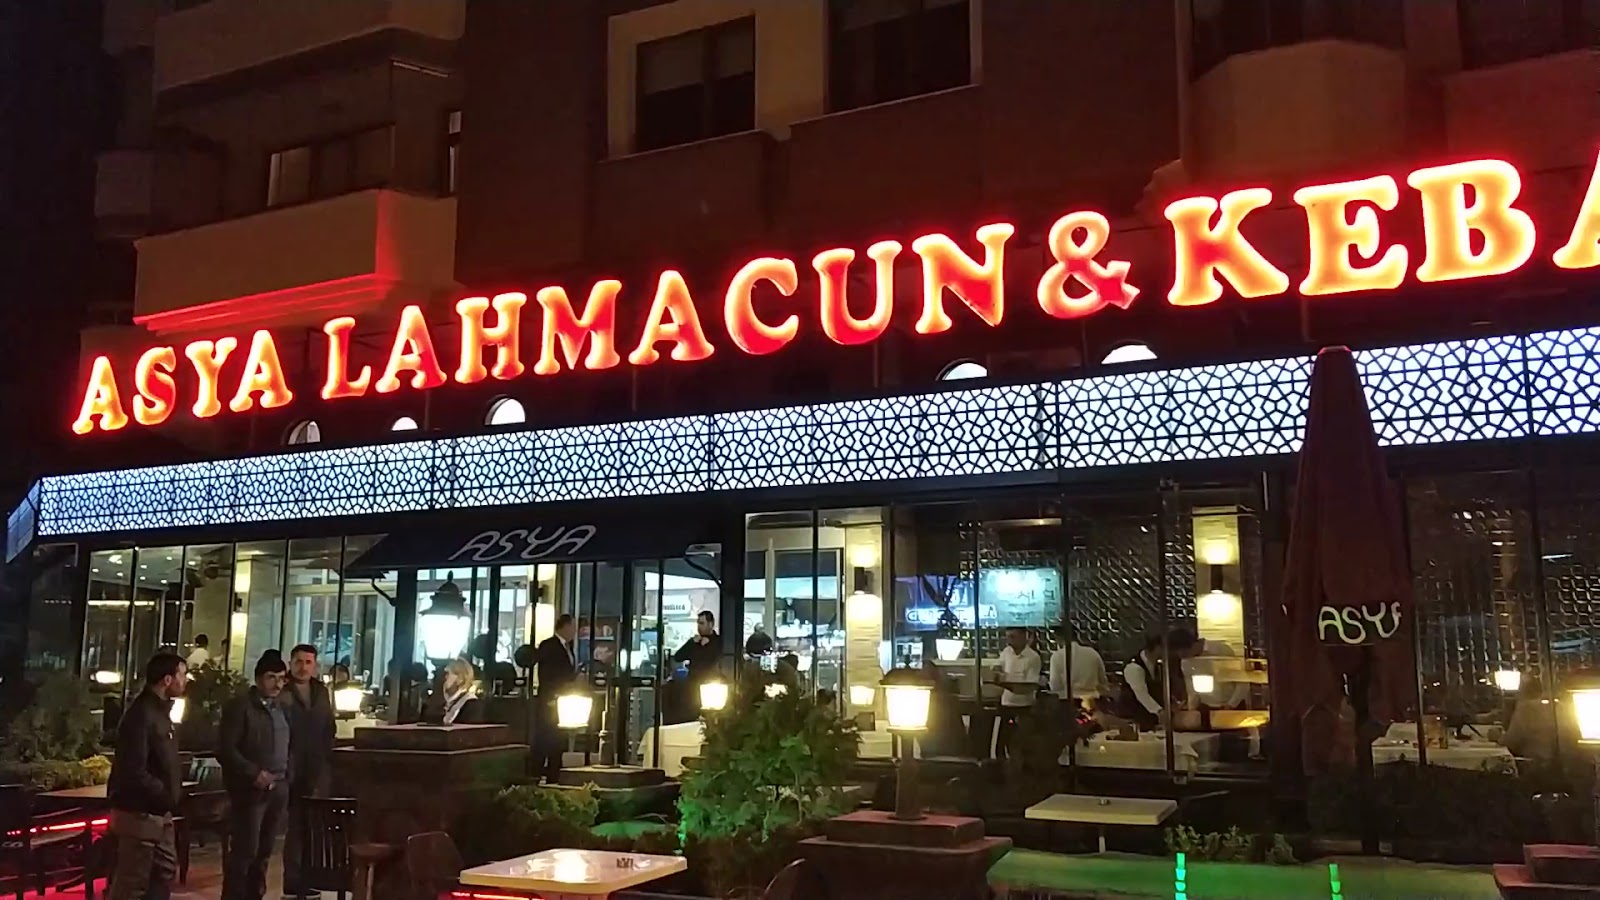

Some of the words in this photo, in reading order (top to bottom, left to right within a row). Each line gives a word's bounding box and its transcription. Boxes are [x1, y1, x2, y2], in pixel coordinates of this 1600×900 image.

[72, 329, 294, 435] ASYA
[321, 222, 1015, 400] LAHMACUN
[1036, 210, 1140, 318] &
[448, 524, 597, 561] ASYA
